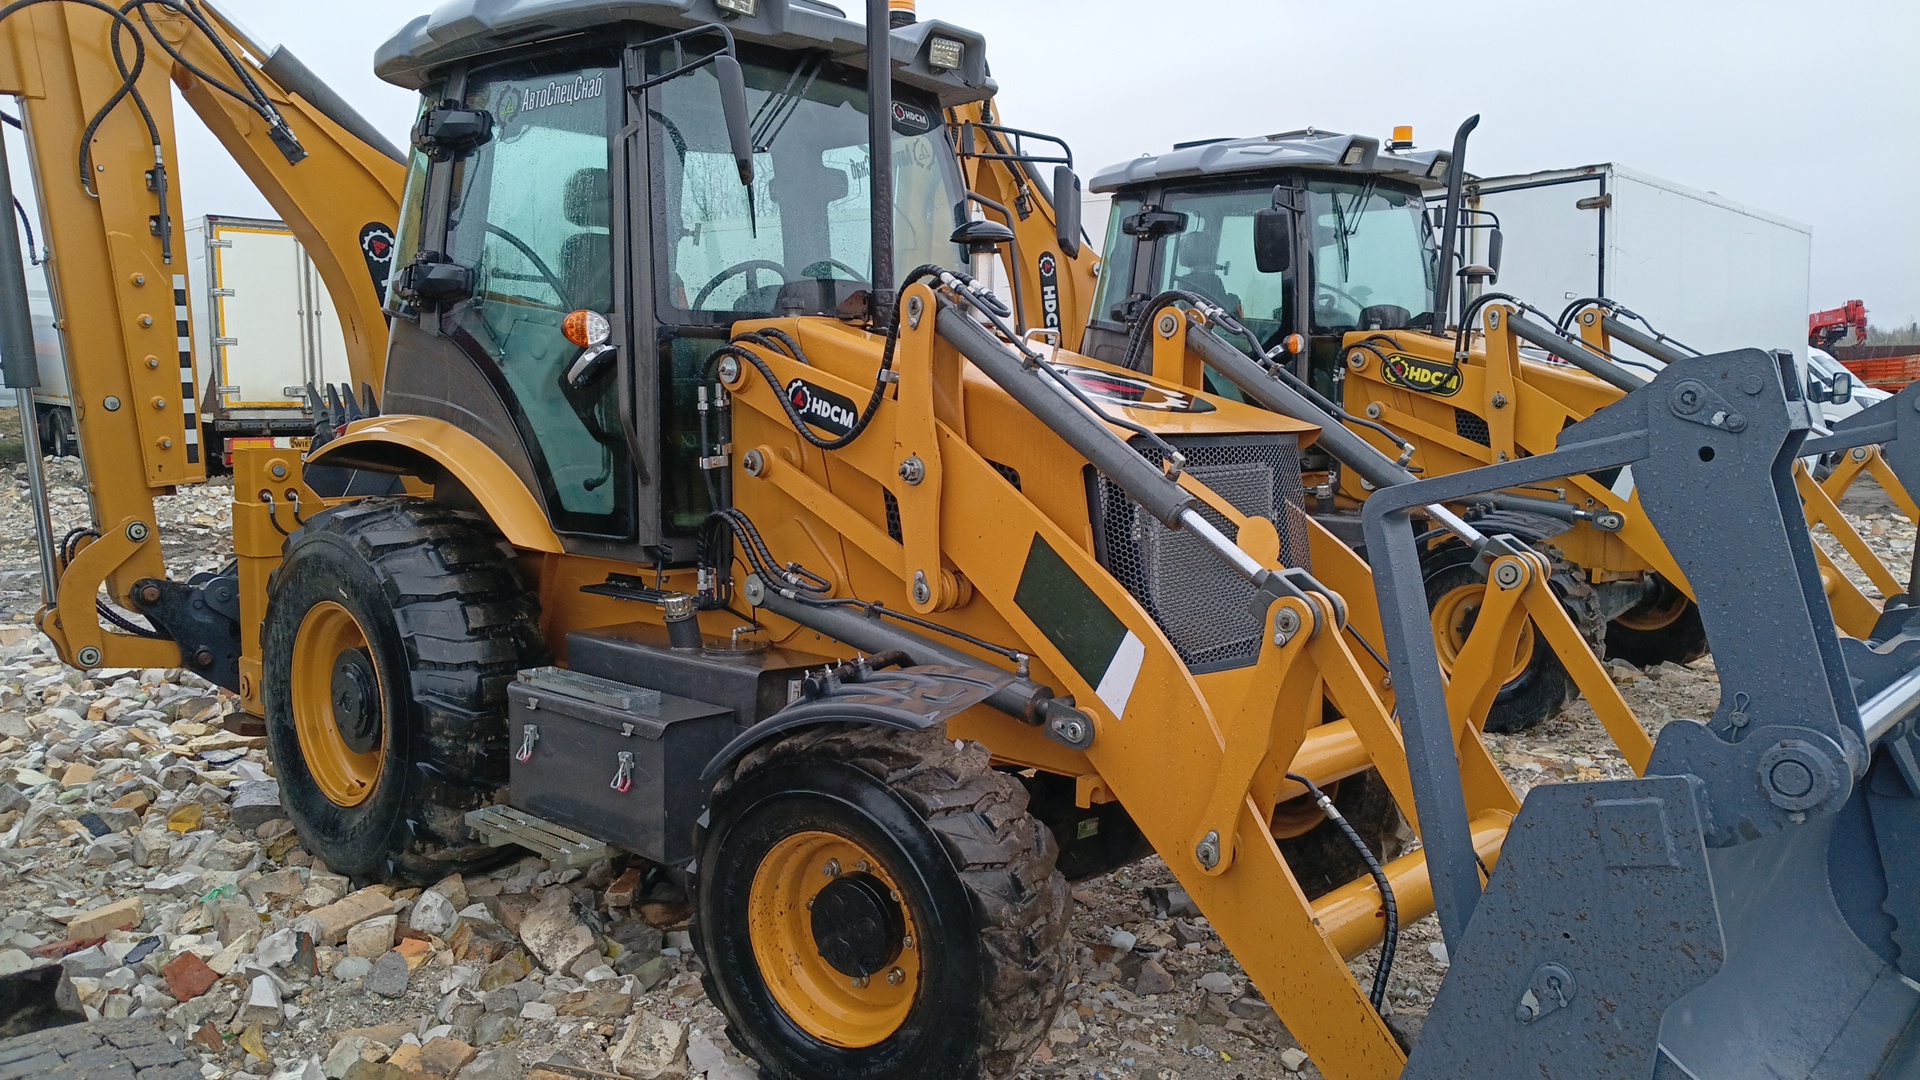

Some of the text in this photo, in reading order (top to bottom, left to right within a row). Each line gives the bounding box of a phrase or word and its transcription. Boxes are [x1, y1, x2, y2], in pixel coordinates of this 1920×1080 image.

[521, 70, 604, 113] АвтоСпецСнаб
[904, 110, 927, 125] HDCM
[811, 396, 855, 429] HDCM
[294, 440, 309, 448] WIE
